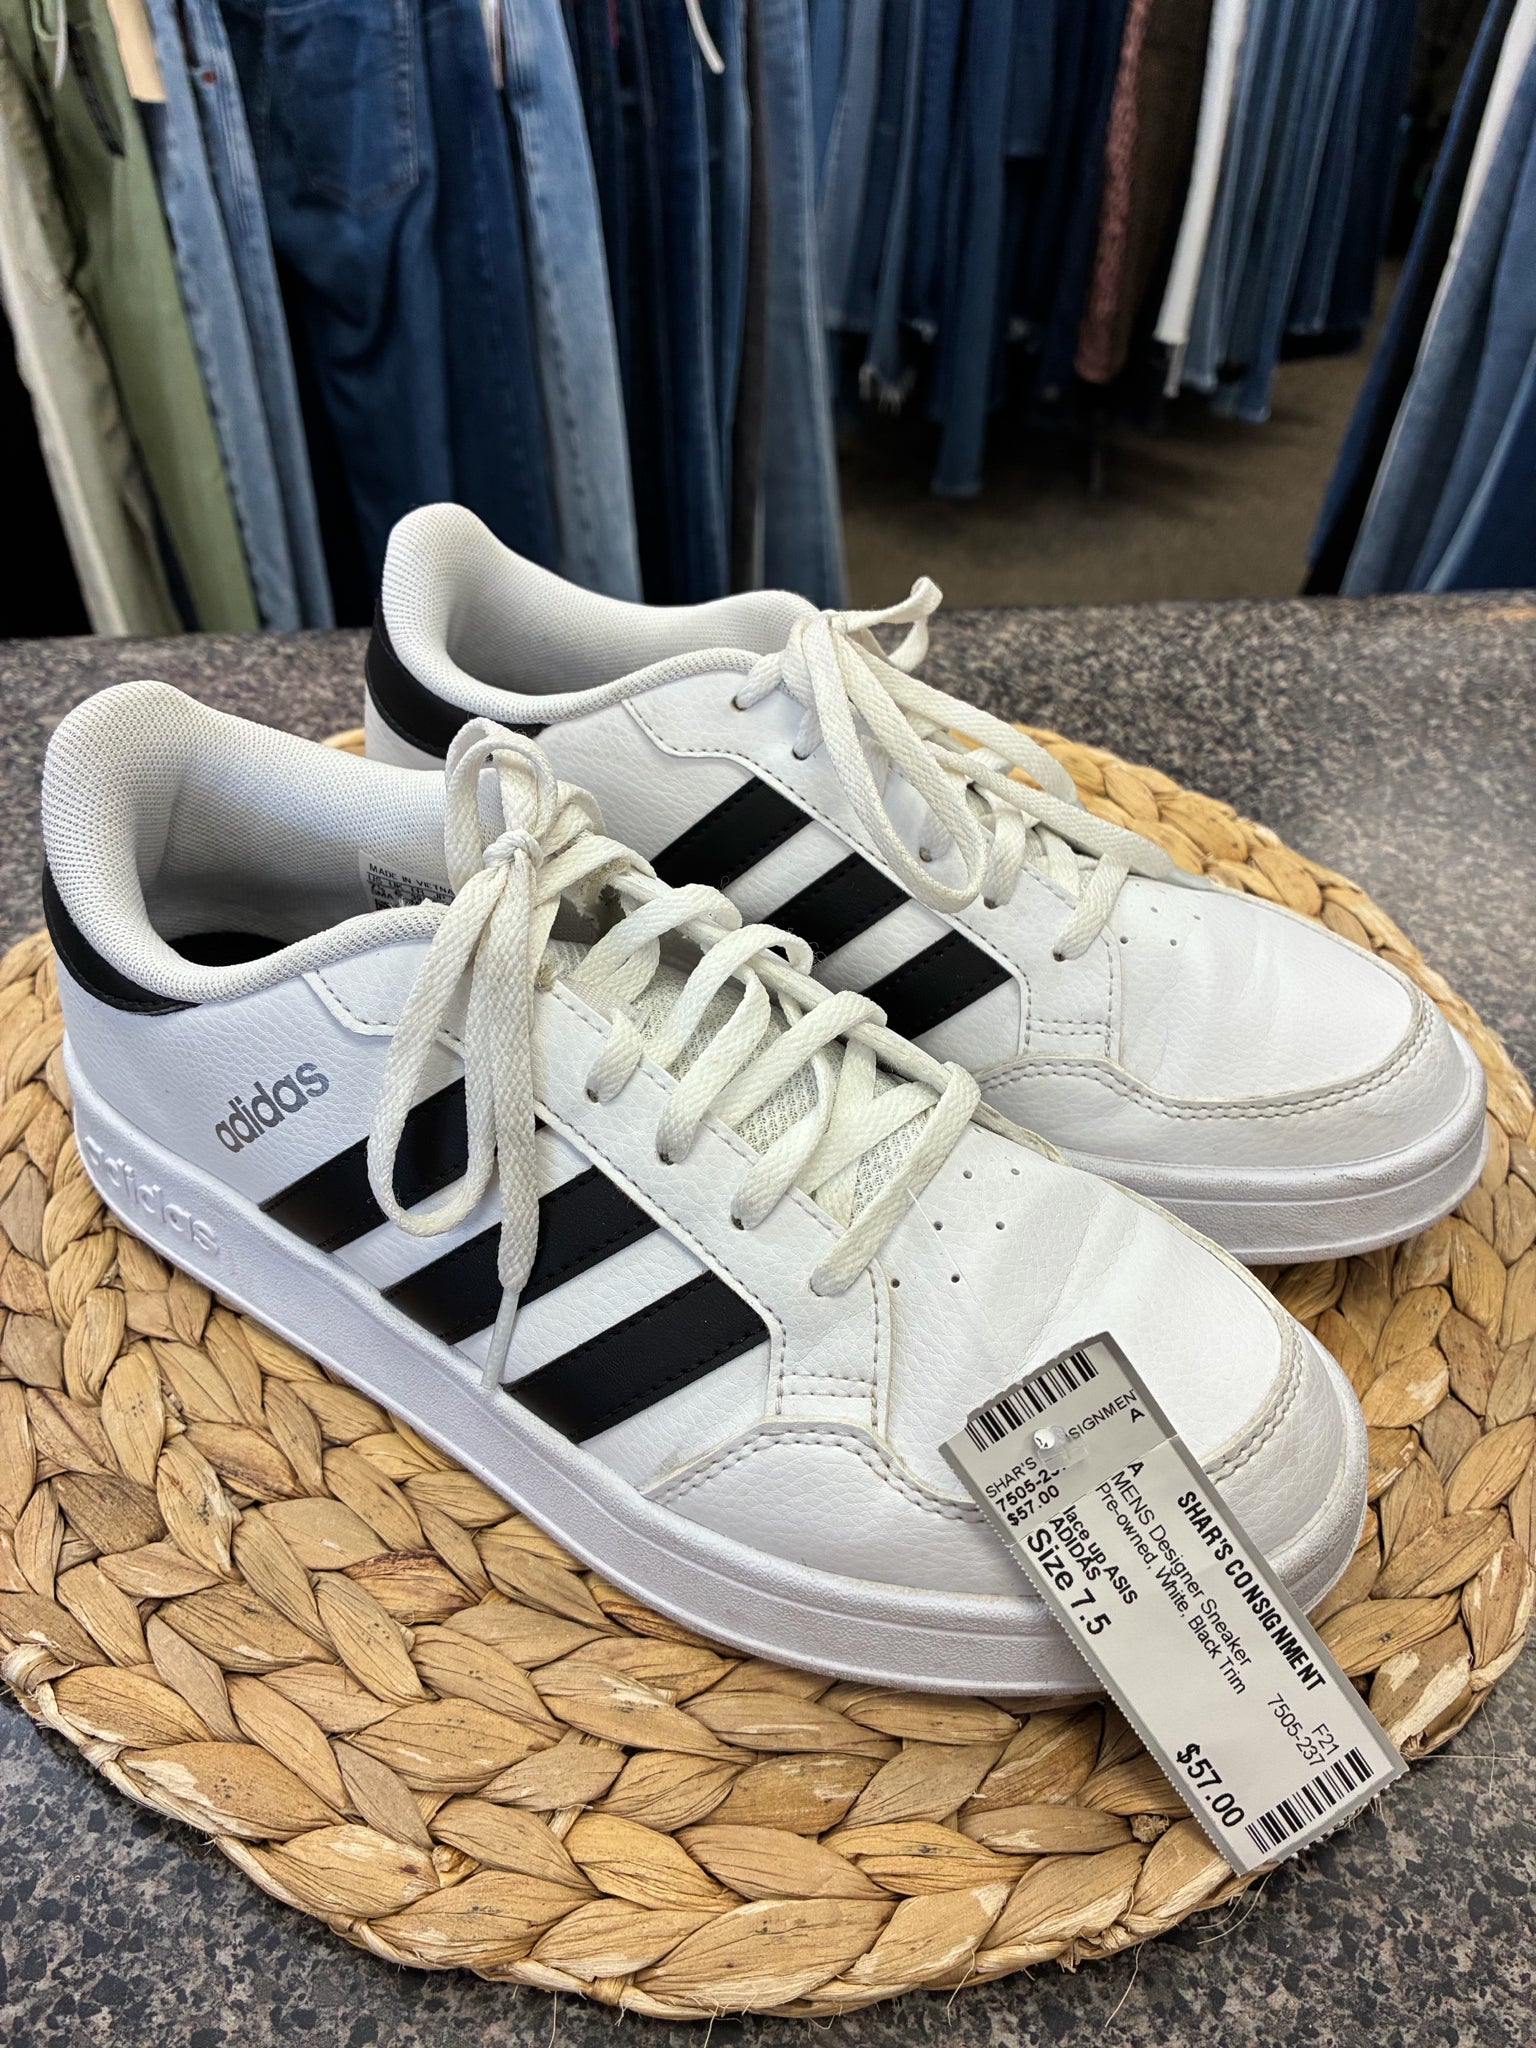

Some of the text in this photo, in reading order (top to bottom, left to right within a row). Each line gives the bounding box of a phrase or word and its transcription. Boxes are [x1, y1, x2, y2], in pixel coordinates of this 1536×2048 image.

[369, 863, 397, 880] MADE
[402, 876, 412, 884] IN
[416, 879, 454, 895] VIETNA
[215, 1062, 330, 1153] adidas
[85, 1135, 220, 1254] adidas
[1130, 1407, 1146, 1424] A
[985, 1457, 1037, 1499] SHAR'S
[1006, 1484, 1060, 1527] $57.00
[1126, 1461, 1145, 1479] A
[1026, 1528, 1112, 1636] Size 7.5
[1048, 1517, 1102, 1582] ADIDAS
[1062, 1504, 1138, 1605] lace up ASIS
[1094, 1482, 1246, 1696] Pre-owned, White, Black Trim
[1110, 1470, 1252, 1667] MENS Designer Sneaker
[1177, 1491, 1327, 1692] SHAR'S CONSIGNMENT
[1267, 1692, 1326, 1767] 7505-237
[1311, 1723, 1340, 1757] F21
[1175, 1743, 1245, 1828] $57.00
